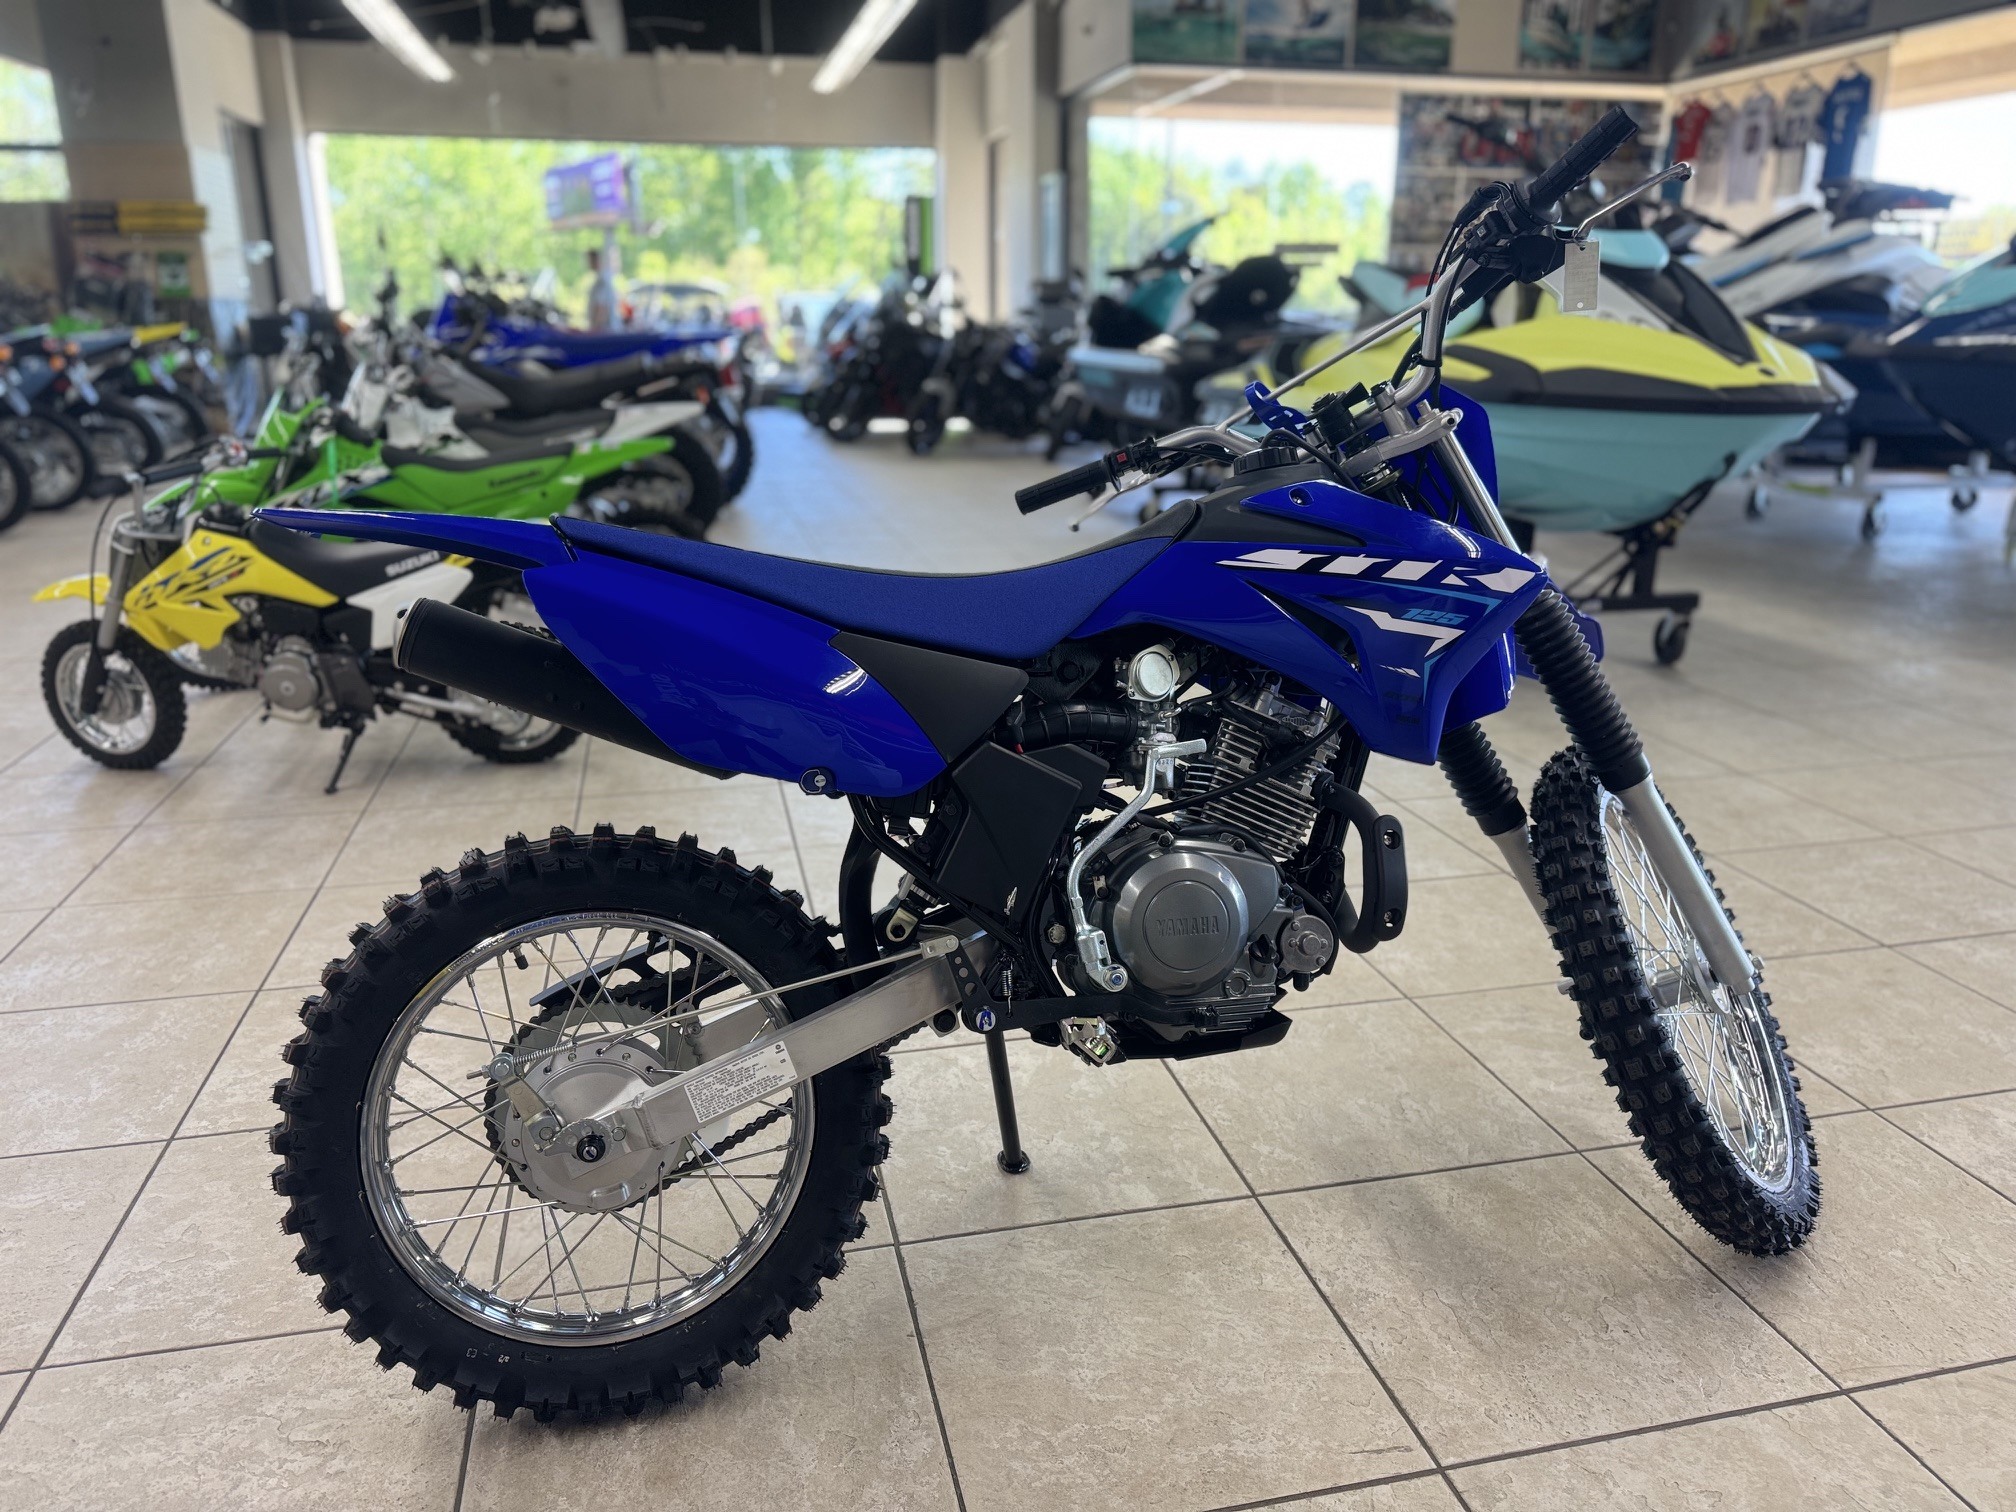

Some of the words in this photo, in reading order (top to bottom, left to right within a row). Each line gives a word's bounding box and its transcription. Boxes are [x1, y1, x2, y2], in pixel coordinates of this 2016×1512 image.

[384, 550, 441, 577] SUZUKI
[1400, 607, 1470, 626] 125
[1155, 915, 1220, 937] YAMAHA
